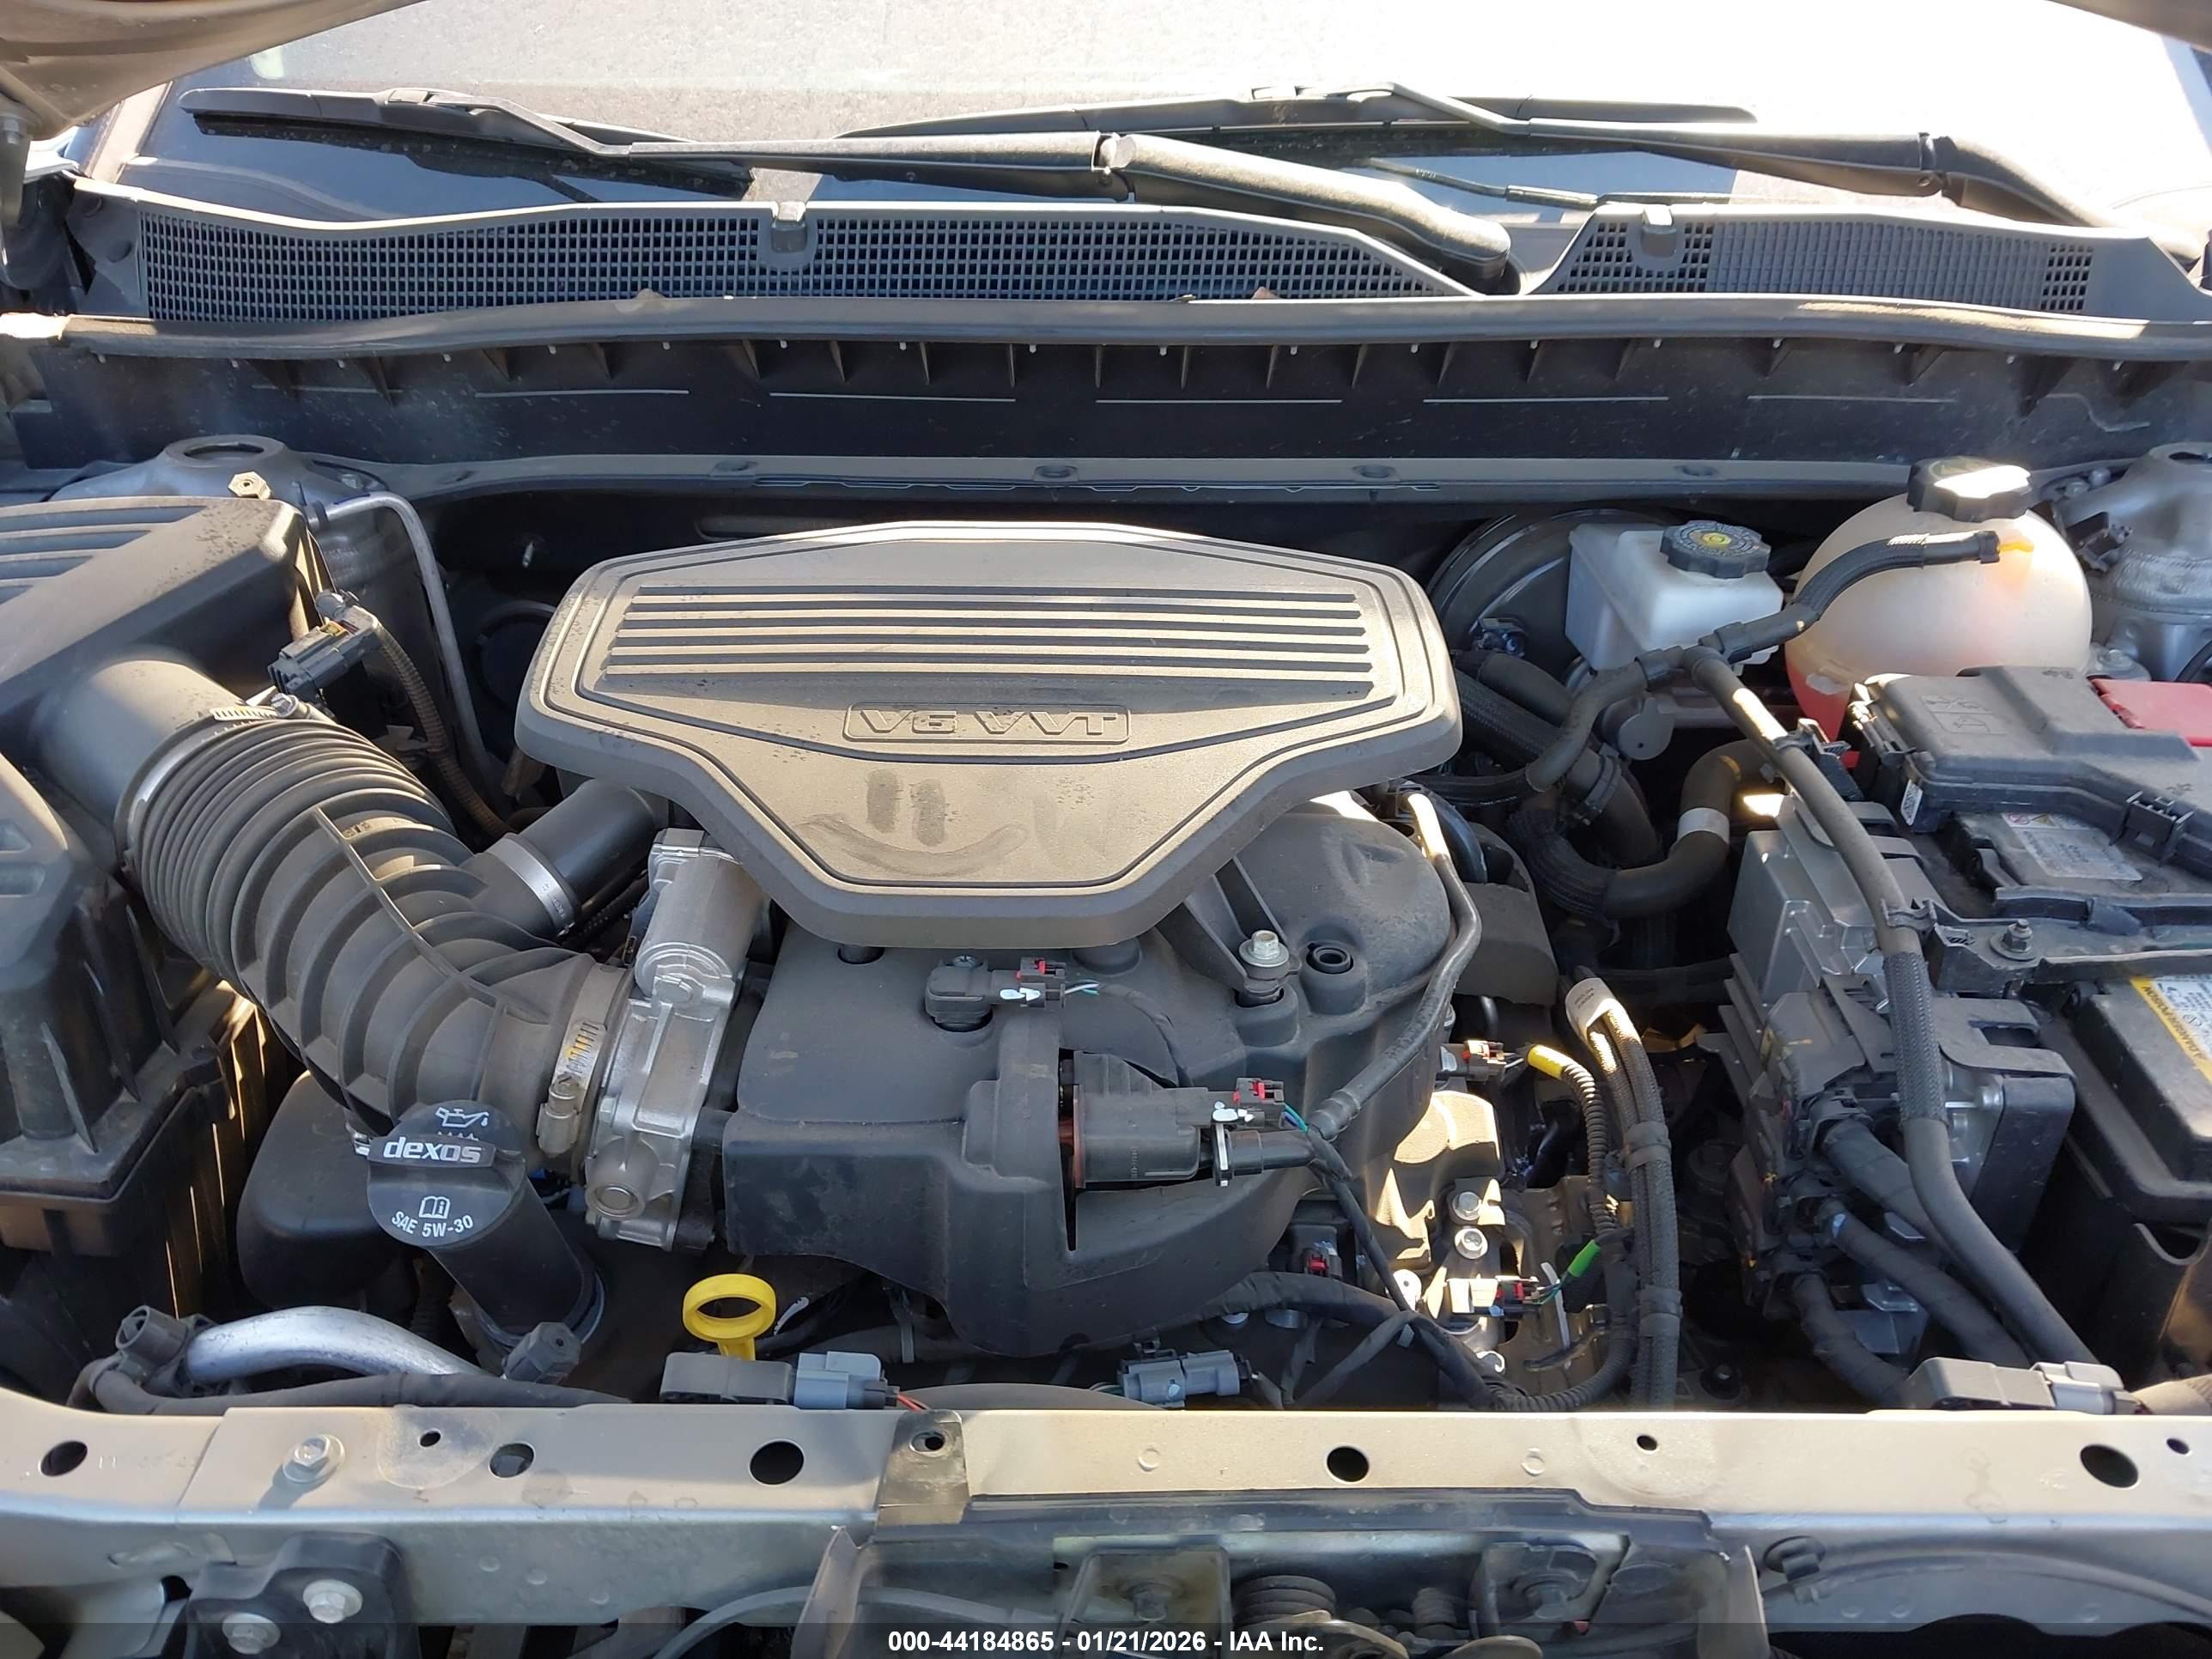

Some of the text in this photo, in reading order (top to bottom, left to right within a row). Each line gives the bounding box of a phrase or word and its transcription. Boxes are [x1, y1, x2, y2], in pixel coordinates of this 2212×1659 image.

[860, 709, 1117, 735] V6 VVT
[383, 1137, 482, 1164] dexos
[392, 1211, 473, 1237] SAE 5W-30
